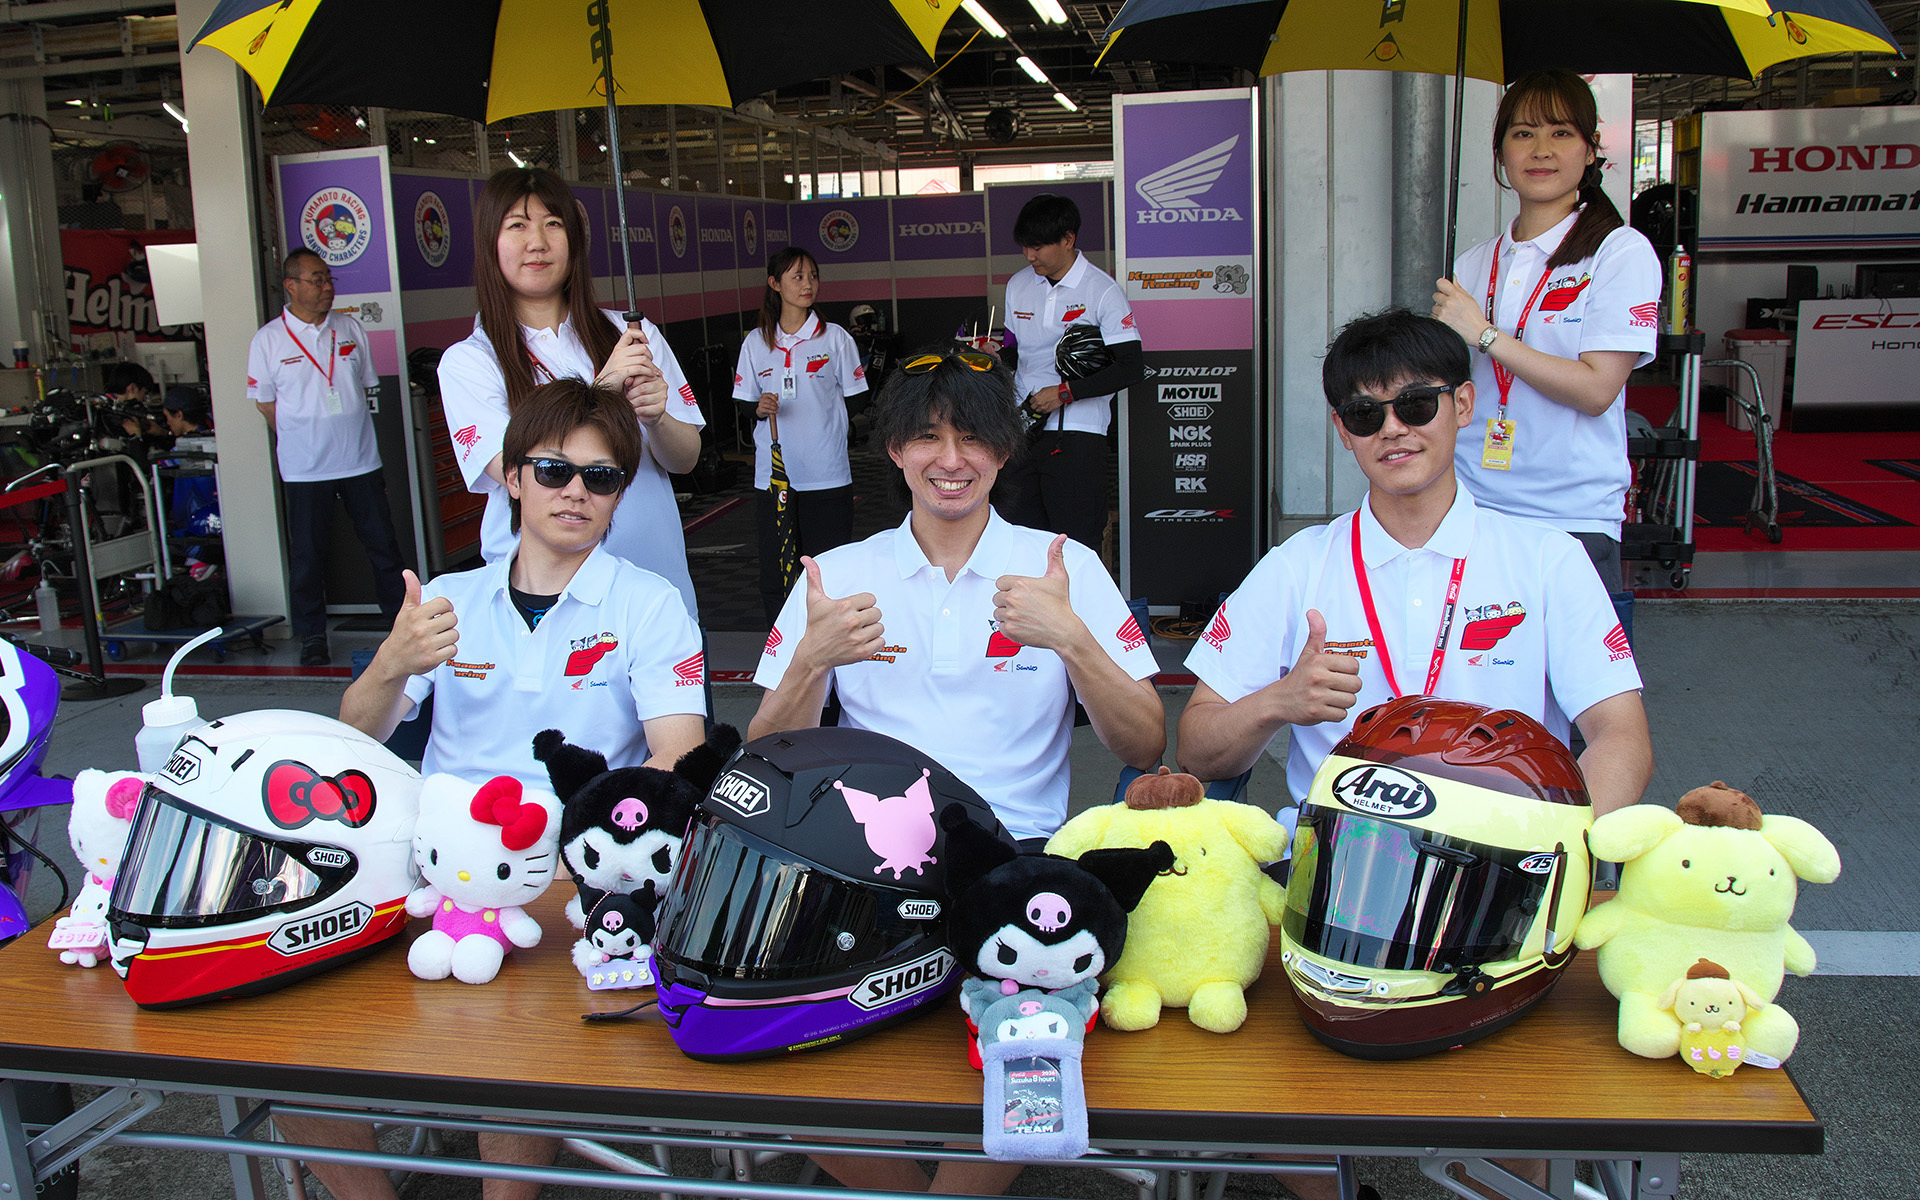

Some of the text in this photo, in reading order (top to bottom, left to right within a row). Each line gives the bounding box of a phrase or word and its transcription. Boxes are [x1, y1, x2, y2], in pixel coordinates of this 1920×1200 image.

[304, 191, 366, 224] KUMAMOTO RACING
[1136, 207, 1243, 224] HONDA
[611, 226, 655, 243] HNDA
[700, 228, 733, 243] HONDA
[766, 229, 788, 242] HONDA
[898, 221, 986, 237] HONDA
[328, 229, 367, 262] CHARACTERS
[1127, 269, 1214, 281] Kumamoto
[1141, 279, 1200, 290] Racing
[1812, 313, 1920, 330] ESC
[1157, 366, 1238, 377] DUNLOP
[1161, 387, 1218, 400] MOTUL
[1173, 406, 1208, 418] SHOEI
[1169, 425, 1212, 441] NGK
[1175, 454, 1207, 467] HSR
[1175, 477, 1207, 490] RK
[1144, 509, 1238, 518] CBR
[162, 753, 197, 780] HOEI
[714, 774, 765, 811] SHOEI
[1334, 767, 1425, 809] Arai
[1353, 797, 1394, 814] HELMET
[313, 850, 345, 865] SHOEI
[904, 903, 936, 916] SHOEI
[284, 906, 362, 949] SHOEI
[867, 955, 945, 1003] SHOEI
[1690, 1044, 1742, 1062] としき
[1010, 1076, 1033, 1084] Suzuka
[1015, 1125, 1055, 1134] TEAM
